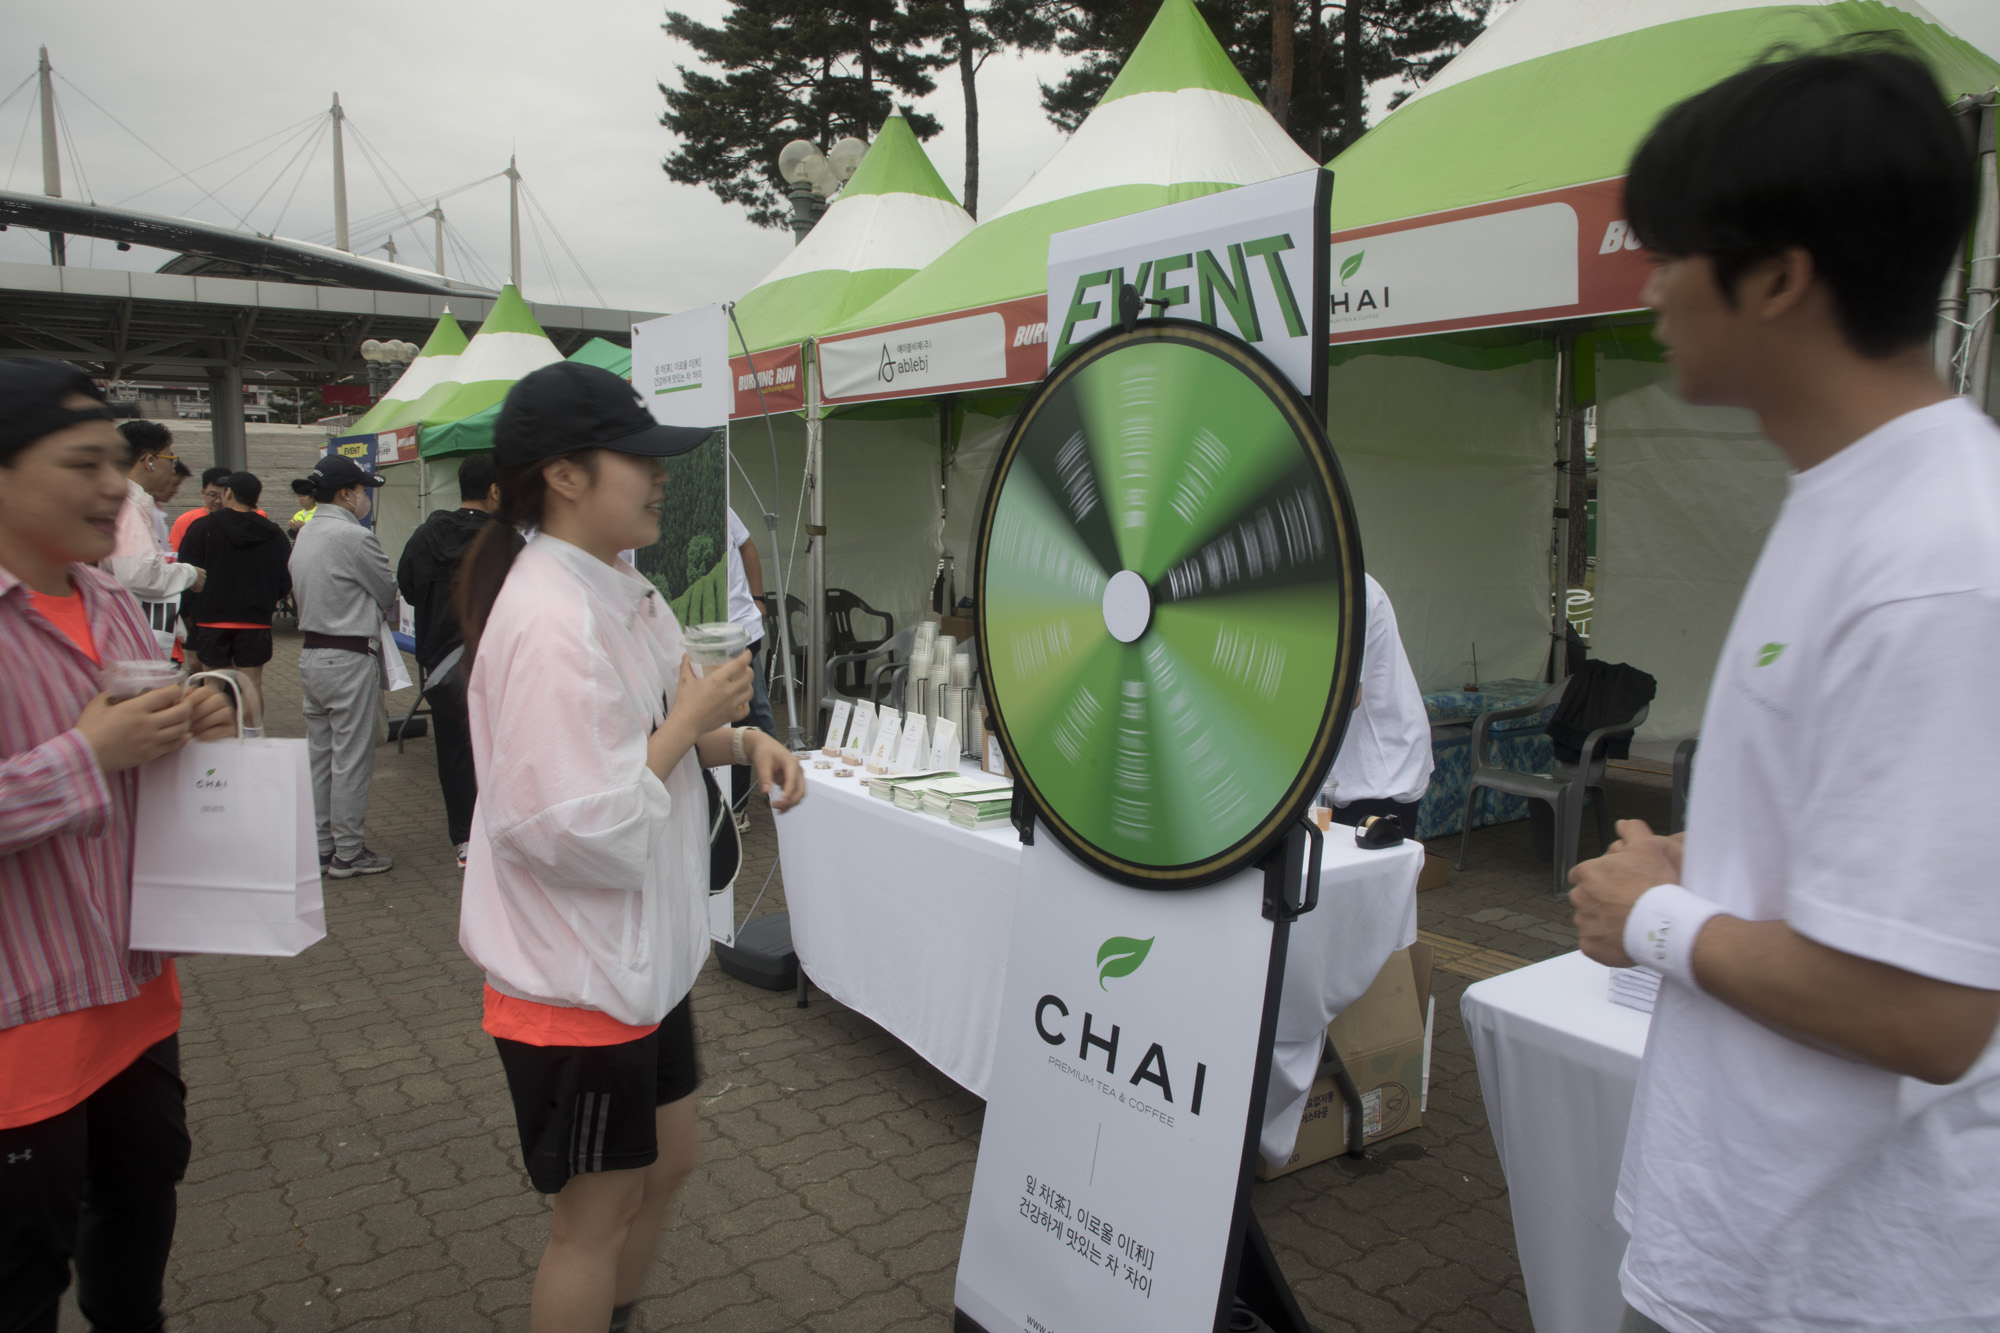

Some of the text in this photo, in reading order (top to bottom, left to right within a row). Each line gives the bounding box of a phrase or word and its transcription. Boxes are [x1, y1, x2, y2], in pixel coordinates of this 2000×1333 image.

[1599, 219, 1643, 253] BU
[1051, 233, 1308, 367] EVENT
[1331, 287, 1389, 315] HAI
[776, 364, 797, 384] RUN
[897, 355, 929, 373] ablebj
[344, 446, 360, 455] EVENT
[1035, 994, 1207, 1116] CHAI
[1048, 1055, 1175, 1128] PREMIUM TEA & COFFEE
[1019, 1196, 1064, 1241] 건강하게
[1066, 1227, 1102, 1266] 맛있는
[1105, 1253, 1119, 1277] 차
[1026, 1174, 1037, 1196] 잎
[1077, 1208, 1114, 1246] 이로울
